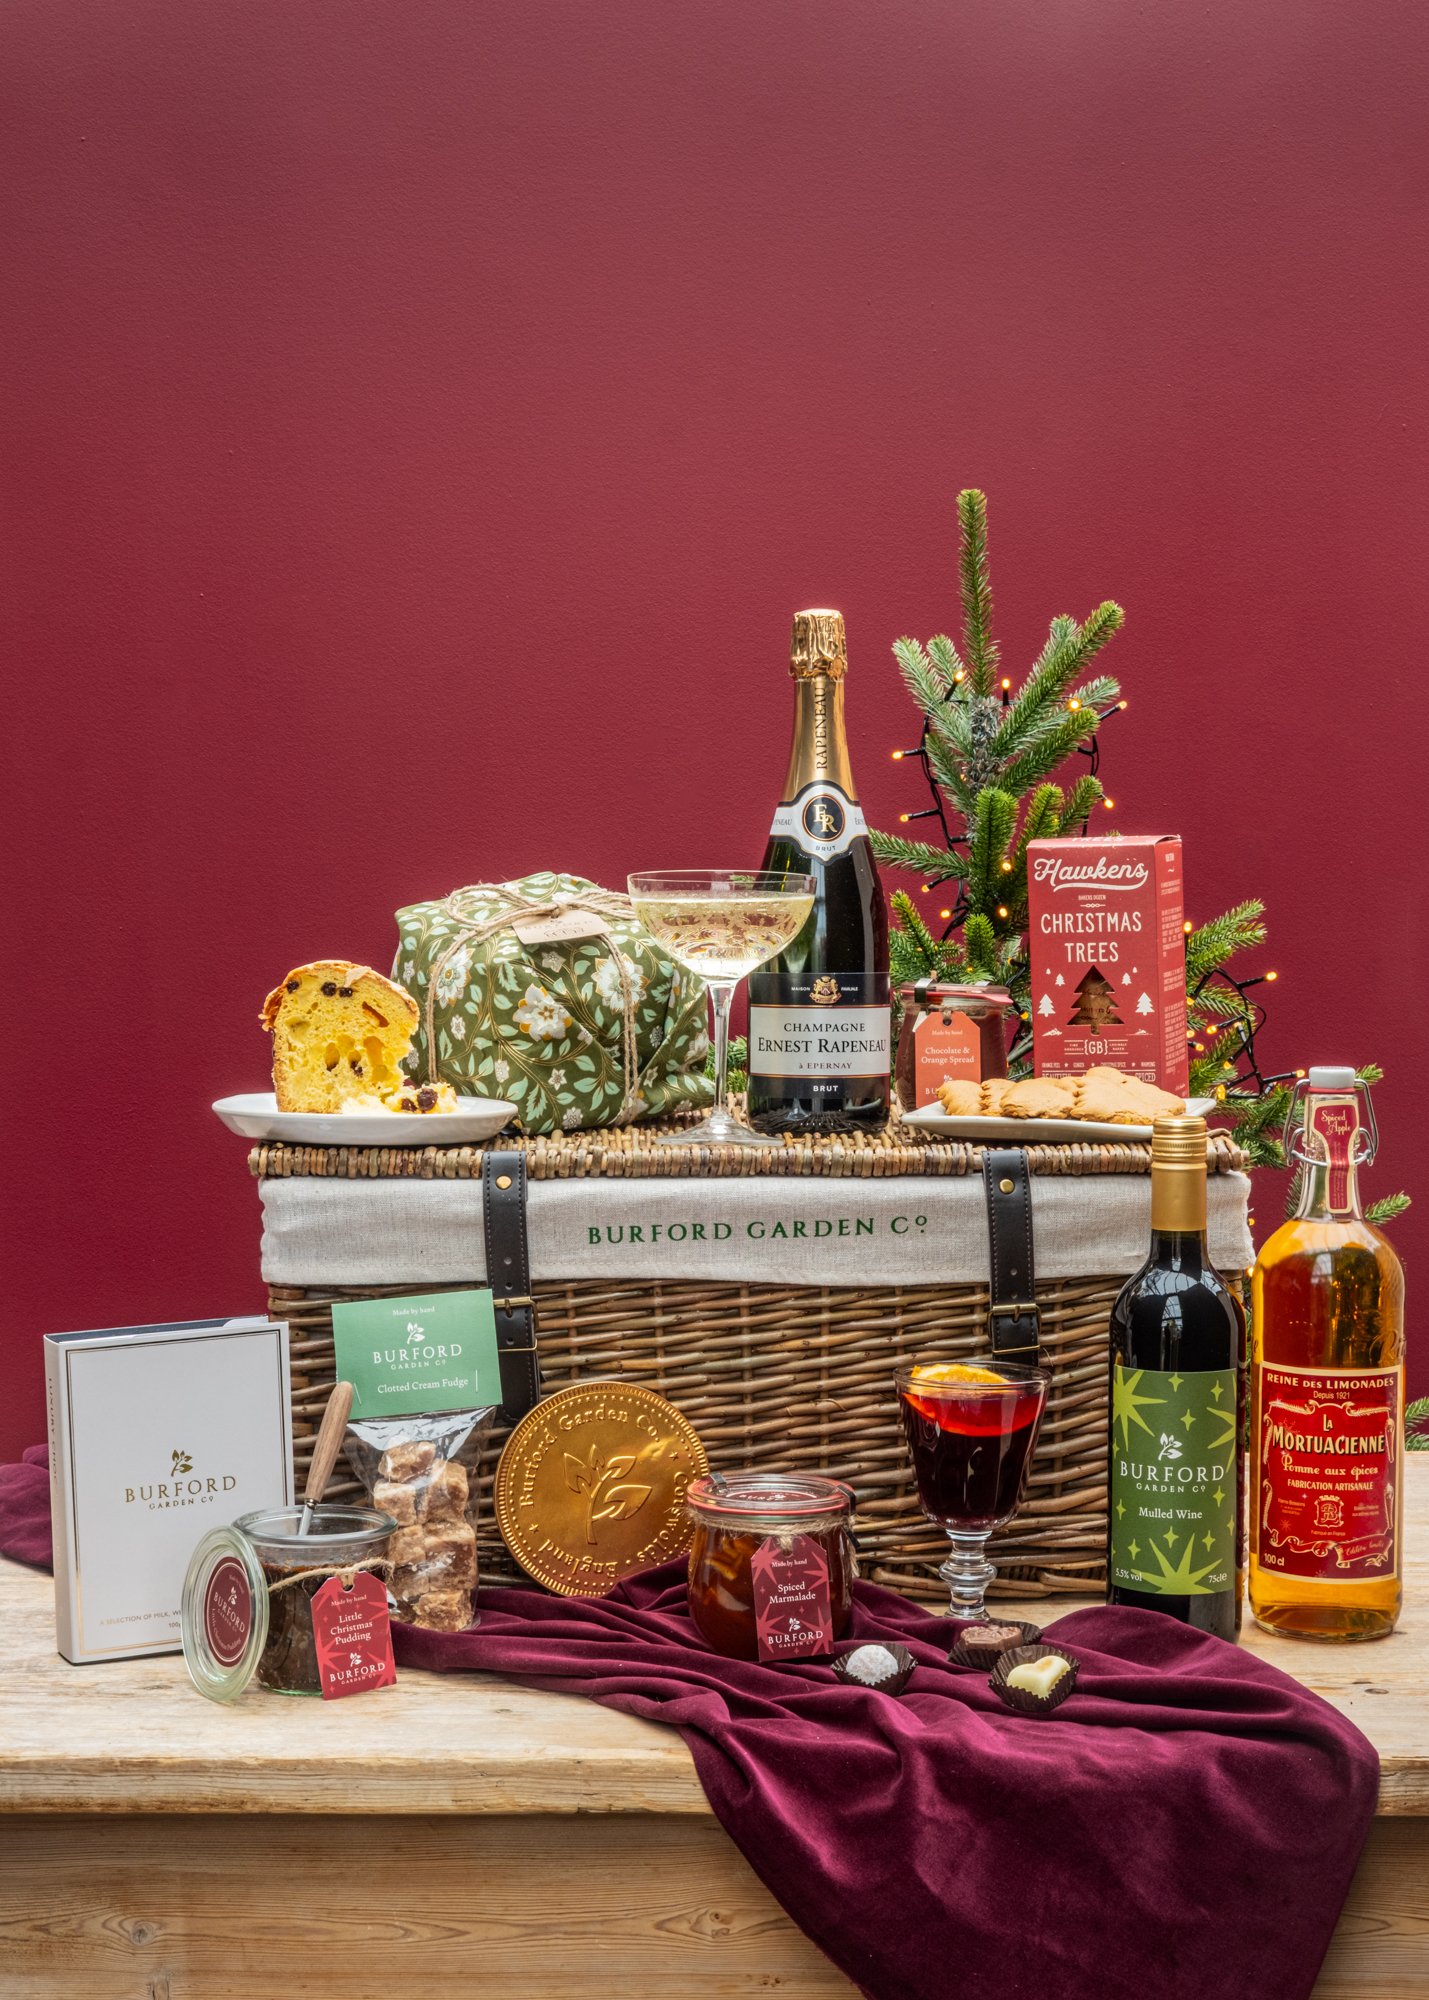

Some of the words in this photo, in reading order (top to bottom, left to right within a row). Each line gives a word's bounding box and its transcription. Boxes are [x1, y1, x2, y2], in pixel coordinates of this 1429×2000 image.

[815, 686, 828, 770] RAPENEAU
[1040, 911, 1142, 934] CHRISTMAS
[1064, 941, 1119, 963] TREES
[783, 1022, 866, 1033] CHAMPAGNE
[757, 1036, 813, 1053] ERNEST
[817, 1038, 887, 1054] RAPENEAU
[925, 1046, 962, 1055] Chocolate
[807, 1062, 853, 1070] EPERNAY
[921, 1056, 948, 1066] Orange
[949, 1056, 975, 1066] Spread
[1321, 1110, 1346, 1126] Spiced
[1325, 1121, 1351, 1136] Apple
[588, 1222, 733, 1245] BURFORD
[747, 1217, 875, 1239] GARDEN
[392, 1309, 410, 1317] Made
[410, 1308, 418, 1316] by
[420, 1306, 435, 1314] hand
[373, 1344, 462, 1364] BURFORD
[390, 1361, 430, 1370] GARDEN
[377, 1382, 410, 1394] Clotted
[411, 1380, 441, 1390] Cream
[442, 1377, 469, 1388] Fudge
[1267, 1372, 1299, 1387] REINE
[1302, 1380, 1322, 1388] DES
[1326, 1377, 1394, 1390] LIMONADES
[1313, 1390, 1334, 1400] Depuis
[1272, 1424, 1385, 1455] MORTUACIENNE
[519, 1427, 558, 1510] Burford
[558, 1403, 630, 1431] Garden
[636, 1414, 660, 1442] Co.
[1120, 1460, 1224, 1482] BURFORD
[1280, 1454, 1320, 1475] Pomme
[1324, 1467, 1346, 1476] aux
[1350, 1464, 1378, 1480] épices
[124, 1475, 236, 1503] BURFORD
[1136, 1482, 1184, 1492] GARDEN
[1287, 1478, 1333, 1491] FABRICATION
[1334, 1482, 1374, 1491] ARTISANALE
[149, 1498, 194, 1510] GARDEN
[1138, 1506, 1173, 1519] Mulled
[1176, 1509, 1202, 1519] Wine
[538, 1538, 620, 1578] England
[794, 1558, 808, 1566] hand
[1264, 1553, 1276, 1564] 100
[1277, 1557, 1284, 1566] cl
[1130, 1572, 1142, 1582] vol
[778, 1581, 806, 1595] Spiced
[353, 1594, 367, 1602] hand
[769, 1592, 816, 1604] Marmalade
[214, 1591, 246, 1633] BURFORD
[338, 1612, 362, 1624] Little
[330, 1620, 373, 1636] Christmas
[335, 1632, 372, 1646] Pudding
[768, 1630, 824, 1645] BURFORD
[330, 1662, 386, 1683] BURFORD
[341, 1676, 366, 1685] GARDEN
